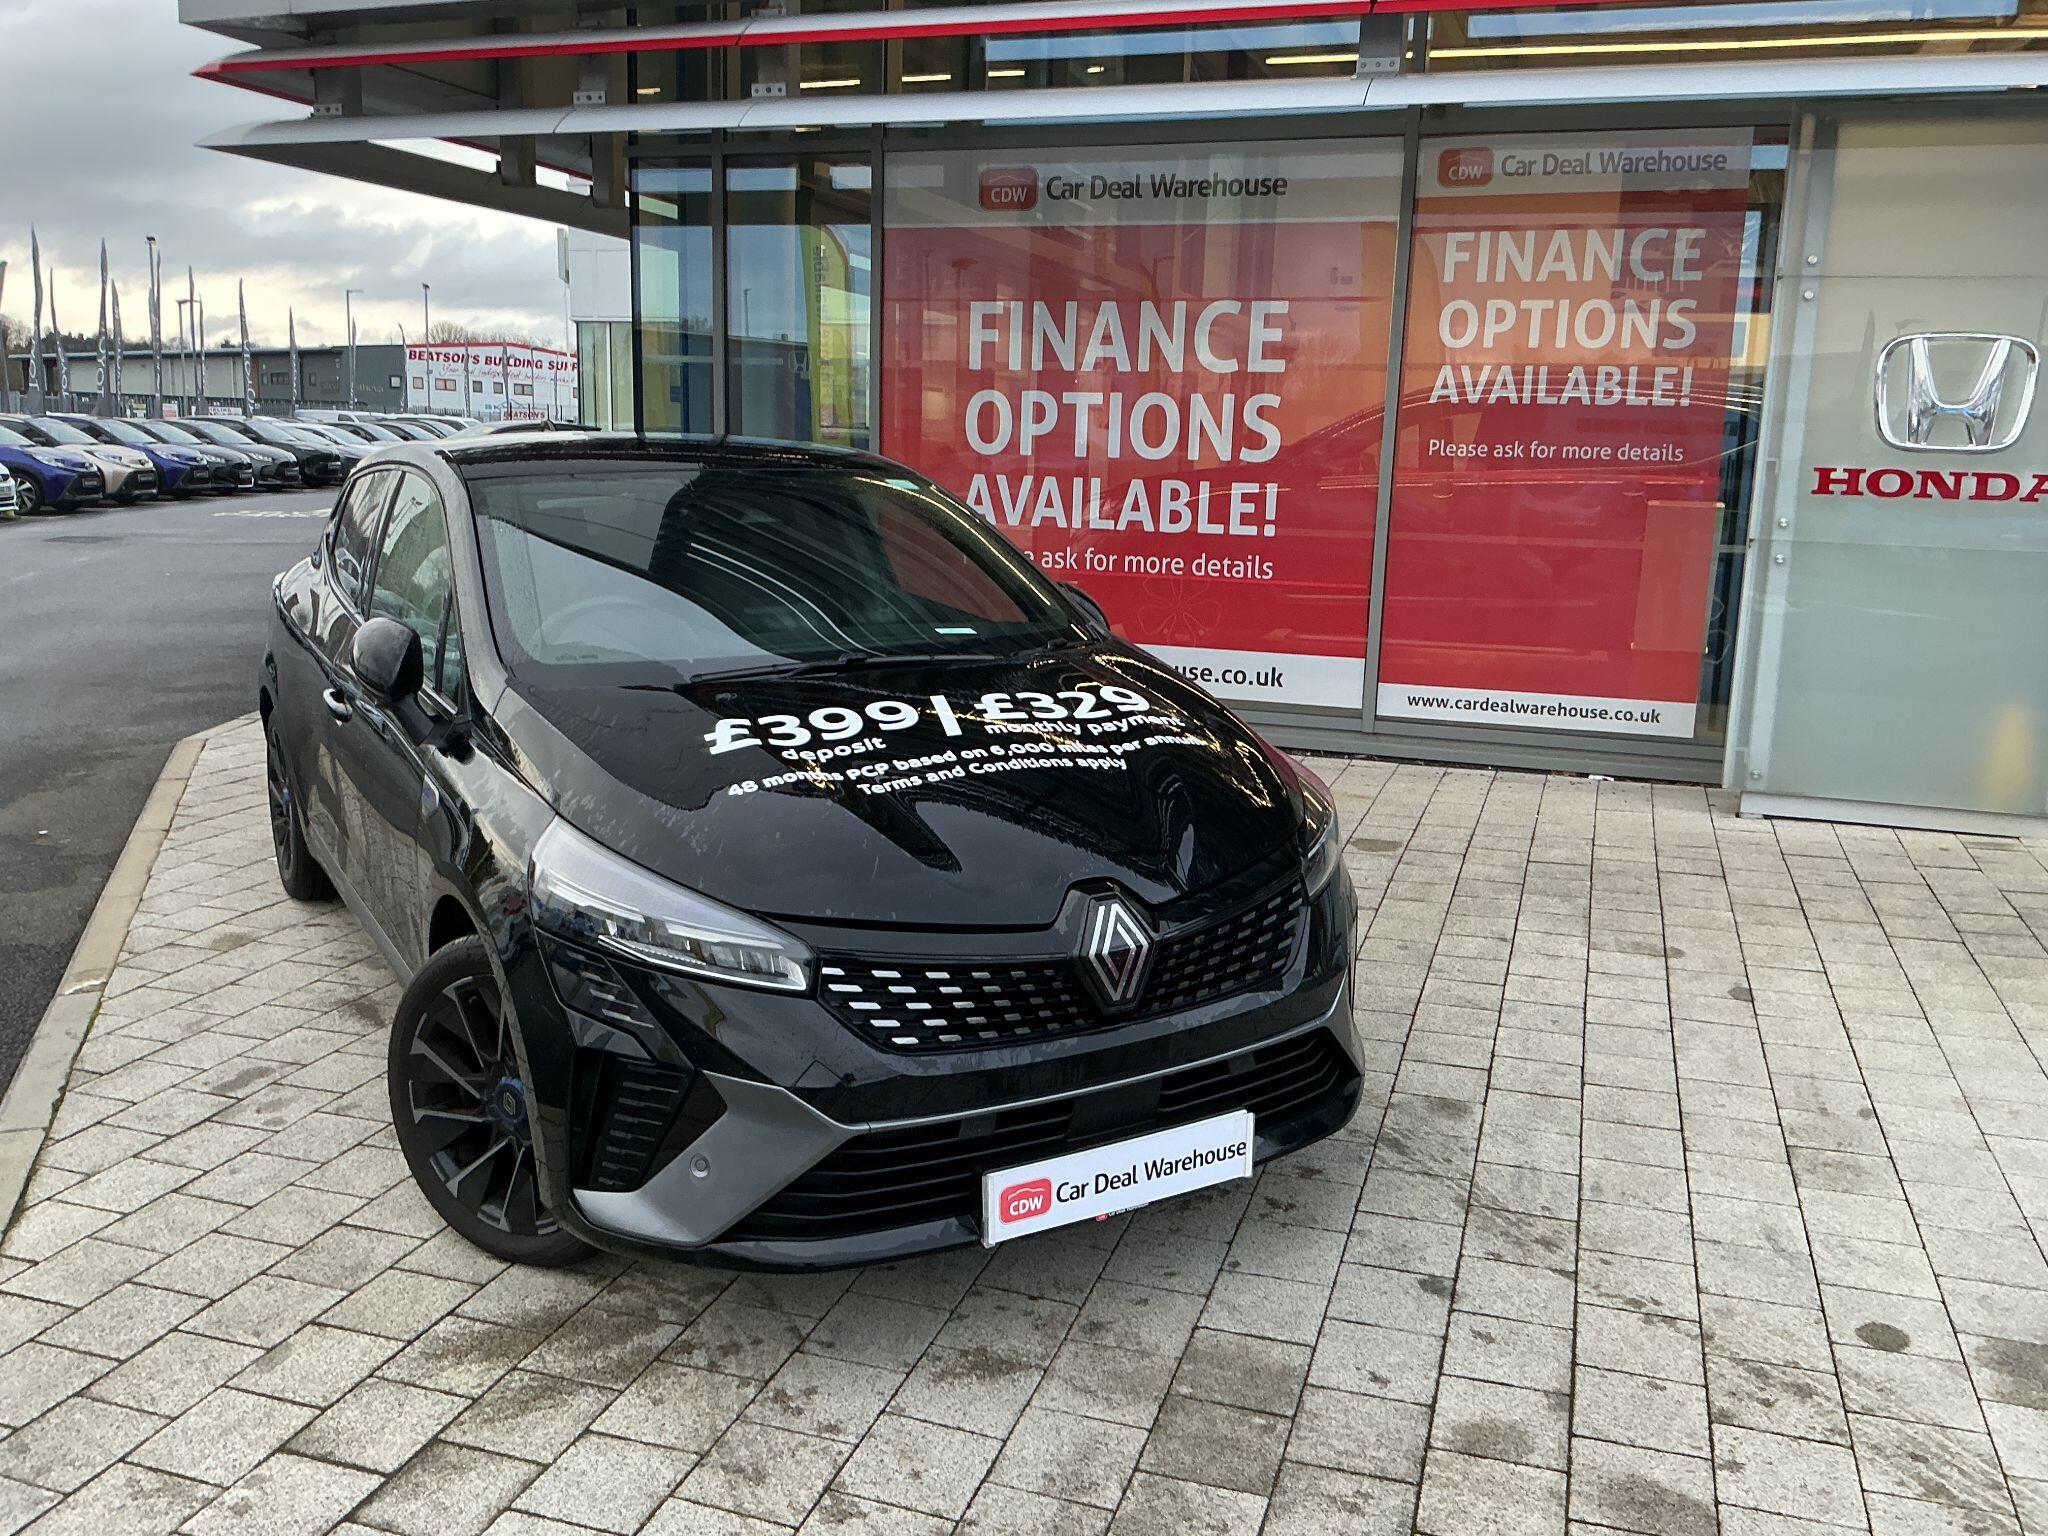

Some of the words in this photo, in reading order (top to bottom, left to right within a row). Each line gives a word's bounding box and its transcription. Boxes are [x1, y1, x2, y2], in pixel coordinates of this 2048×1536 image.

[1449, 165, 1483, 181] CDW
[1501, 154, 1536, 177] Car
[1542, 153, 1591, 176] Deal
[1600, 150, 1728, 174] Warehouse
[991, 187, 1027, 202] CDW
[1047, 176, 1084, 200] Car
[1090, 174, 1142, 200] Deal
[1150, 172, 1287, 199] Warehouse
[1443, 228, 1707, 283] FINANCE
[968, 300, 1289, 374] FINANCE
[1439, 298, 1698, 349] OPTIONS
[485, 355, 543, 370] BULDING
[1428, 365, 1694, 407] AVAILABLE!
[965, 389, 1282, 463] OPTIONS
[1428, 439, 1488, 457] Please
[1493, 440, 1524, 457] ask
[1529, 440, 1557, 458] for
[1562, 445, 1611, 461] more
[1617, 443, 1684, 462] details
[965, 473, 1279, 538] AVAILABLE!
[1811, 467, 2048, 503] HONDA
[1041, 547, 1078, 571] ask
[1084, 548, 1118, 572] for
[1124, 555, 1184, 576] more
[1191, 553, 1274, 580] details
[1174, 665, 1284, 688] use.co.uk
[703, 700, 919, 755] £399
[974, 685, 1151, 720] £329
[1407, 694, 1661, 724] www.cardealwarehouse.co.uk
[781, 737, 887, 763] deposit
[984, 718, 1082, 736] monthly
[1087, 713, 1186, 736] payment
[728, 779, 759, 797] 48
[762, 770, 844, 789] months
[846, 762, 890, 781] PCP
[892, 750, 958, 771] based
[960, 747, 988, 761] on
[990, 742, 1056, 758] 6,000
[1059, 742, 1109, 755] miles
[1110, 739, 1142, 756] per
[1144, 734, 1208, 747] annum
[856, 775, 923, 795] Terms
[925, 764, 966, 783] and
[968, 757, 1074, 775] Conditions
[1076, 757, 1127, 771] apply
[1009, 1195, 1043, 1217] CDW
[1056, 1179, 1090, 1203] Car
[1094, 1165, 1139, 1195] Deal
[1144, 1140, 1247, 1180] Warehouse
